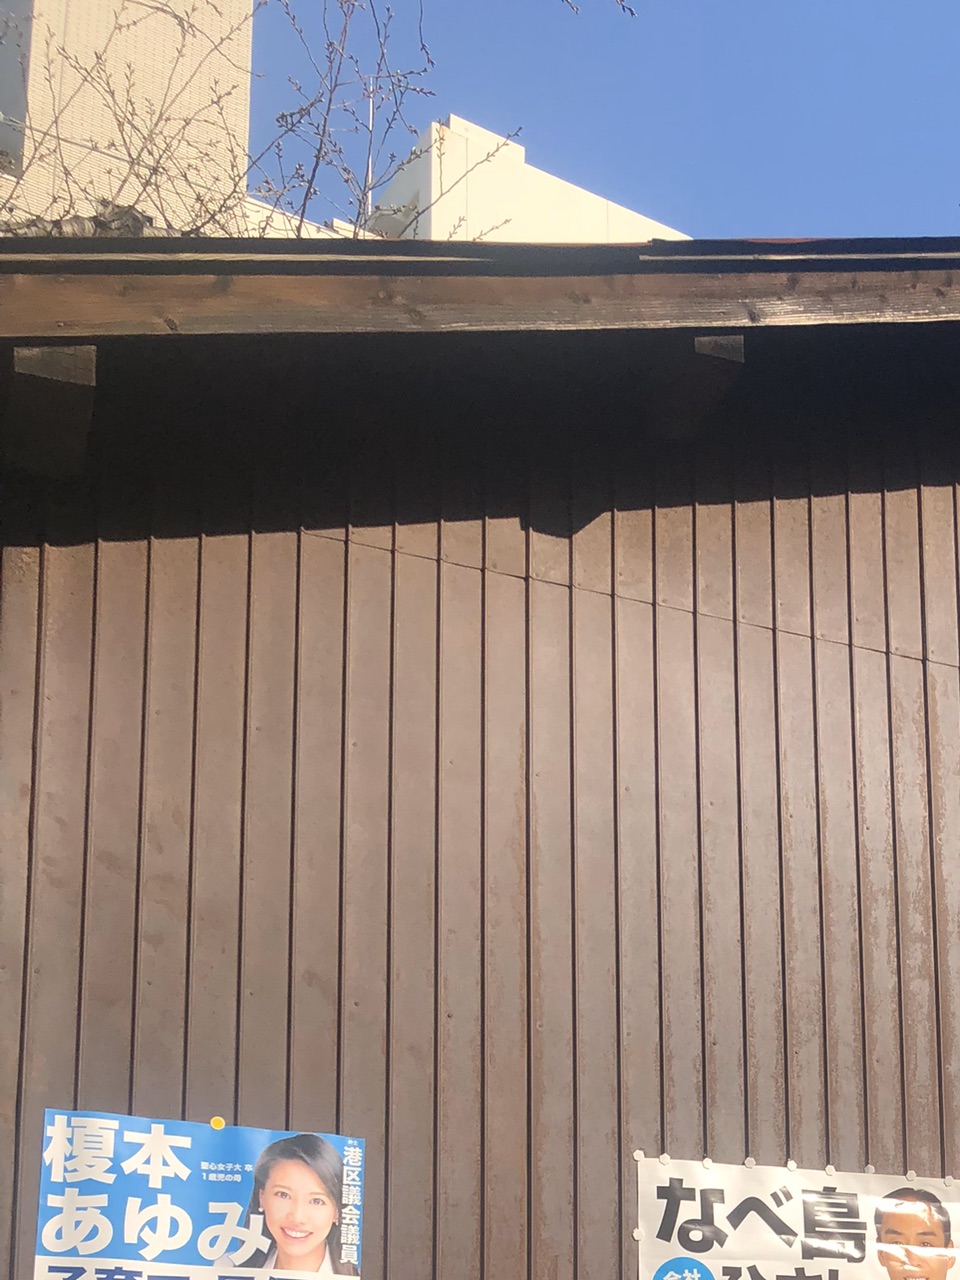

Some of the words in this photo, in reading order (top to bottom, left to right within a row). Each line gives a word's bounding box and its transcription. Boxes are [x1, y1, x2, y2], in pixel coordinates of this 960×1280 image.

[43, 1115, 192, 1189] 榎本
[41, 1188, 272, 1266] あゆみ
[340, 1146, 363, 1265] 港区議会議員
[655, 1177, 868, 1263] なべ島
